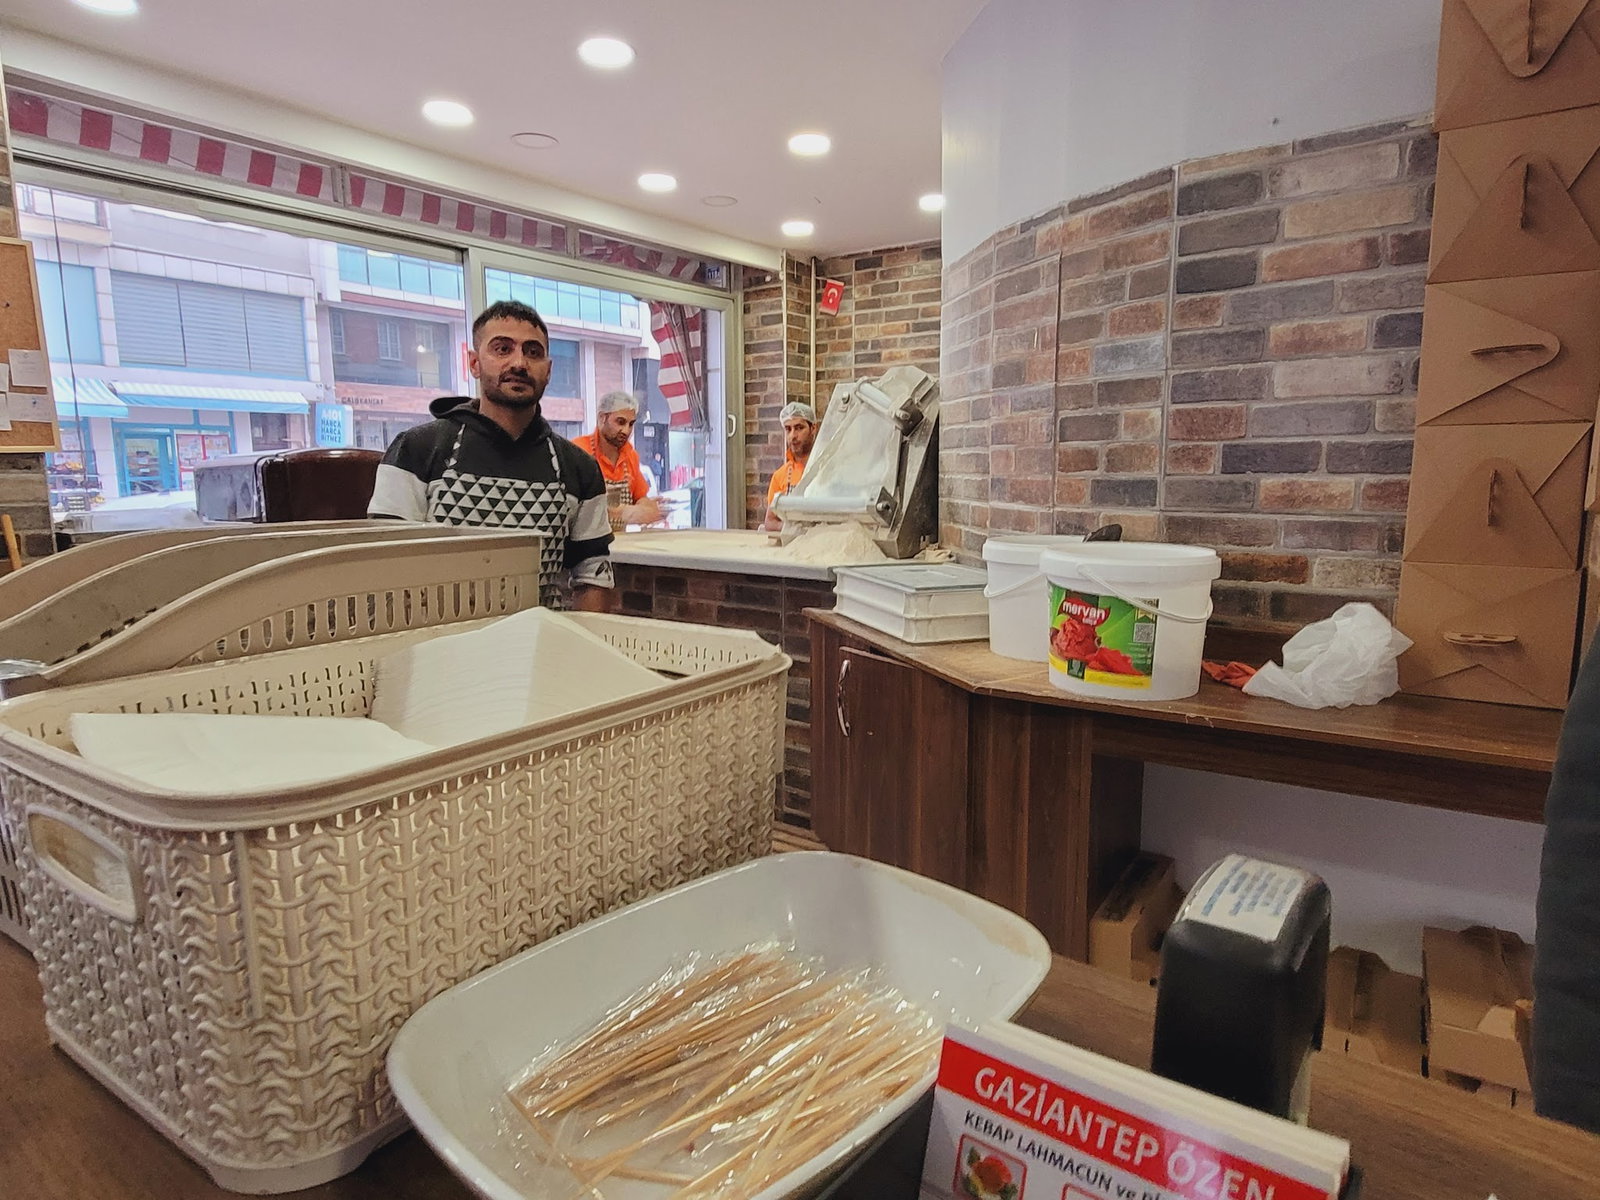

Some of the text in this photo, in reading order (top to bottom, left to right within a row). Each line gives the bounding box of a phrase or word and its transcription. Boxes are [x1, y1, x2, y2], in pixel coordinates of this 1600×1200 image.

[964, 1109, 1014, 1144] KEBAP
[1016, 1135, 1113, 1193] LAHMACUN
[974, 1067, 1276, 1200] GAZİANTEP ÖZEN
